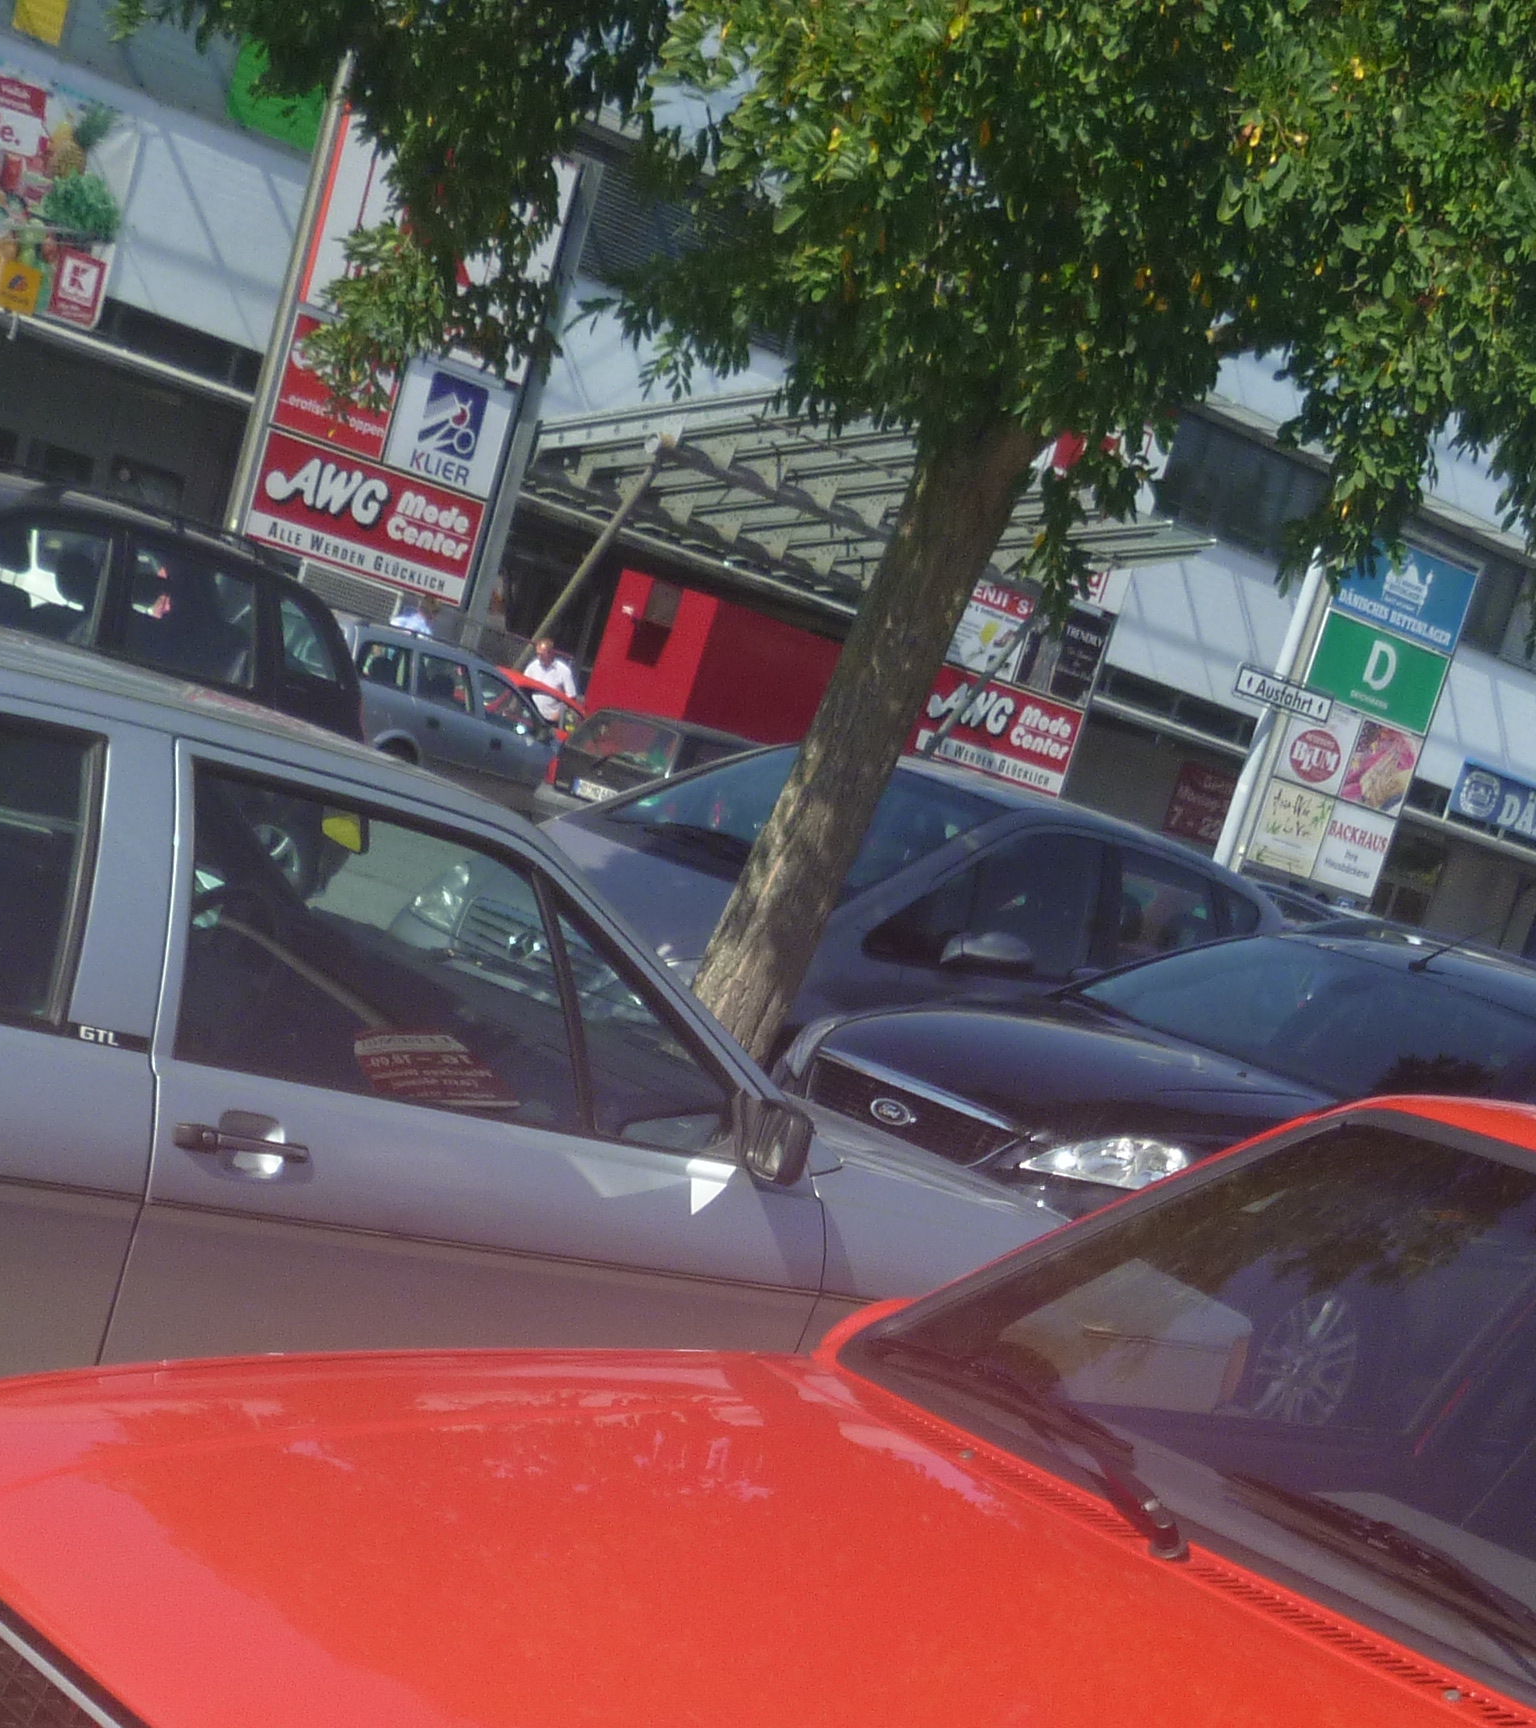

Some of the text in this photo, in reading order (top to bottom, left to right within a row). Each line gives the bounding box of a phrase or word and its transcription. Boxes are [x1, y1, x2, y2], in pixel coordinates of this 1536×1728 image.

[410, 449, 470, 487] KLIER
[264, 457, 391, 528] AWG
[396, 490, 470, 535] Mode
[386, 515, 470, 561] Center
[1338, 586, 1390, 623] DÄNISCHES
[1388, 607, 1452, 648] BETTENLAGER
[1362, 639, 1398, 691] D
[1255, 679, 1315, 714] Ausfahrt
[1018, 704, 1072, 739] Mode
[1010, 727, 1070, 761] Center
[1327, 819, 1389, 853] BACKHAUS
[79, 1025, 119, 1047] GTL
